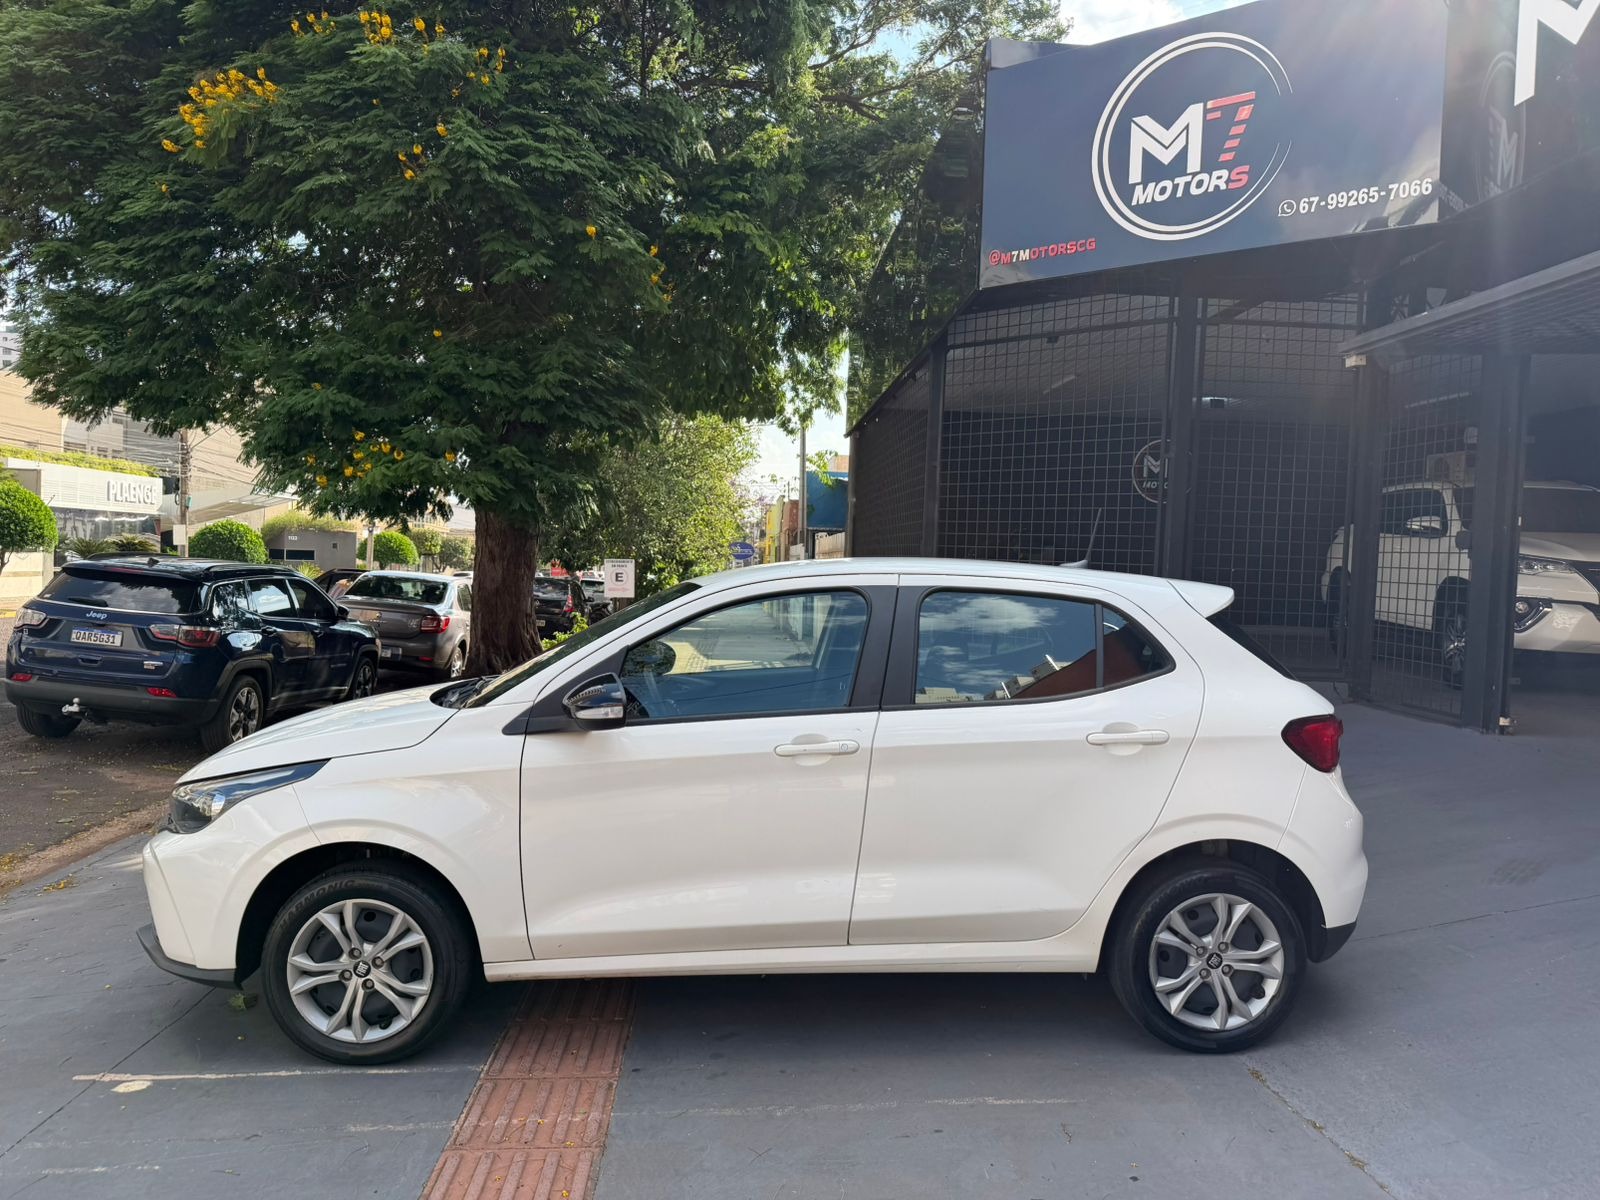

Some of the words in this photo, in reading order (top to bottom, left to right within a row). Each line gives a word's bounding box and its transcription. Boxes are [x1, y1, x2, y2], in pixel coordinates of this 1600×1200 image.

[1129, 90, 1256, 185] M7
[1131, 165, 1250, 206] MOTORS
[1299, 177, 1433, 214] 67-99265-7066
[989, 237, 1096, 266] @M7MOTORSCG
[106, 480, 159, 505] PLAENGE
[615, 572, 624, 582] E
[86, 610, 107, 620] Jeep
[75, 631, 116, 645] QAR5G31
